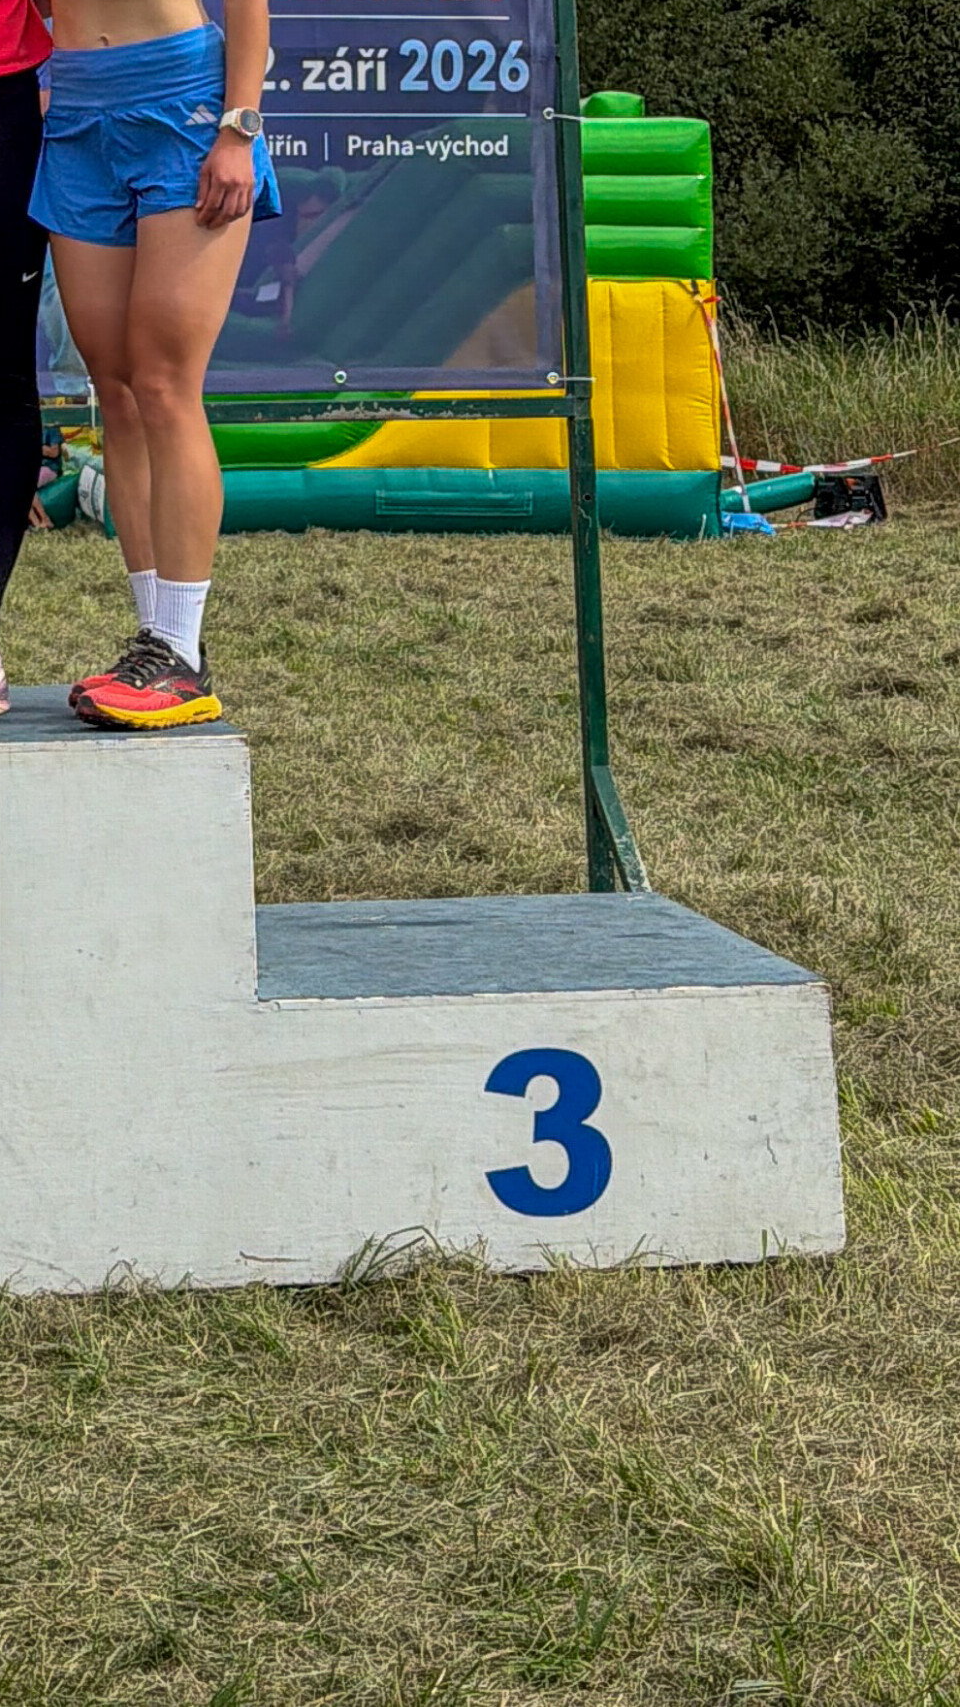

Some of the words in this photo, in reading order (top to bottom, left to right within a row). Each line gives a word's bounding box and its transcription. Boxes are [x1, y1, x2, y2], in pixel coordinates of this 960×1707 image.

[302, 46, 389, 91] září
[400, 39, 530, 92] 2026
[348, 135, 509, 162] Praha-východ
[486, 1048, 612, 1217] 3
